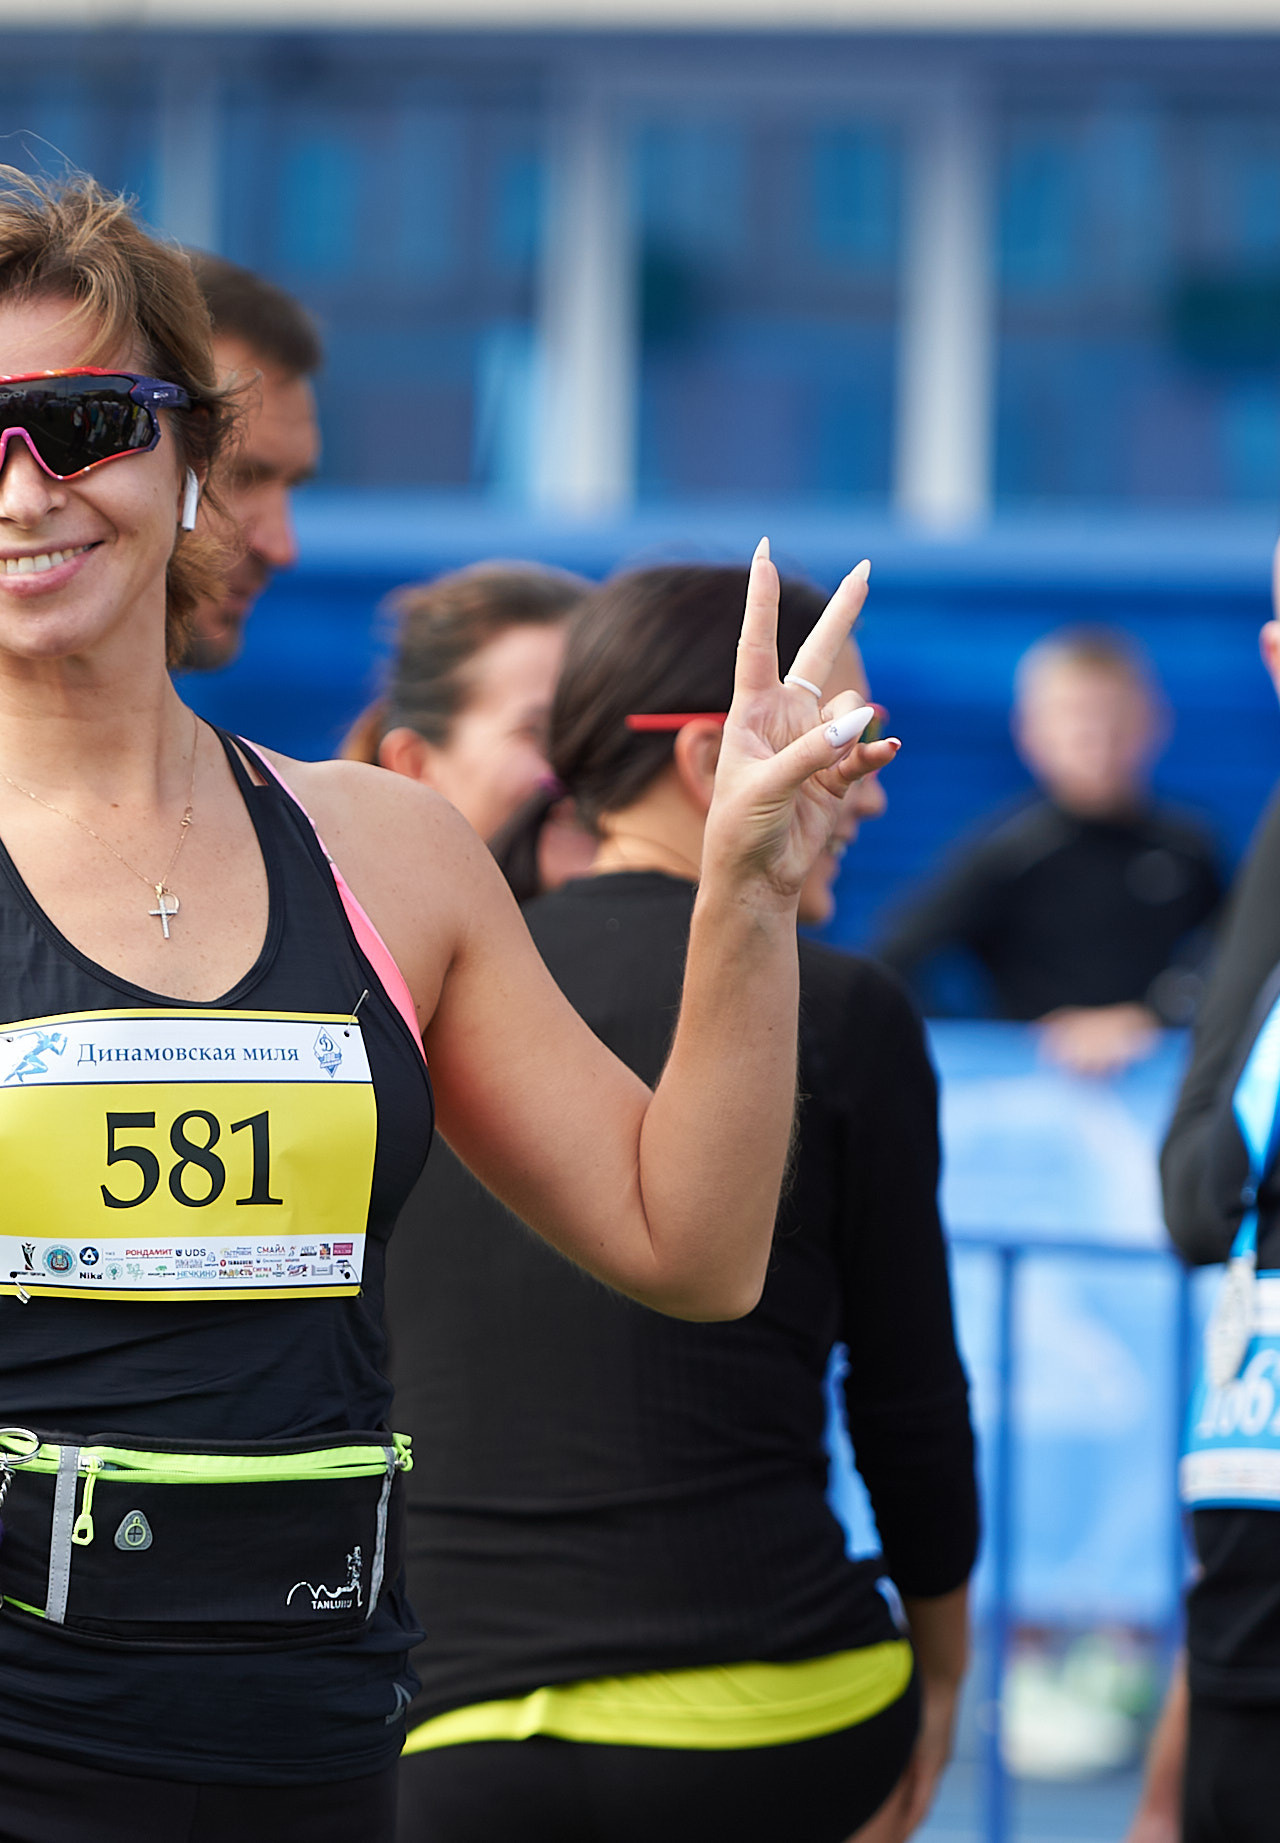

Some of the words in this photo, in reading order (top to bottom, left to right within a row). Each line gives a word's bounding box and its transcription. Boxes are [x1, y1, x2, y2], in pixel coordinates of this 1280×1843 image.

[77, 1043, 236, 1067] Динамовская
[243, 1047, 299, 1062] миля
[100, 1110, 283, 1209] 581
[125, 1248, 173, 1258] РОНДАМИТ
[184, 1248, 207, 1257] UDS
[79, 1271, 104, 1280] Nika
[177, 1270, 218, 1279] НЕЧКИНО
